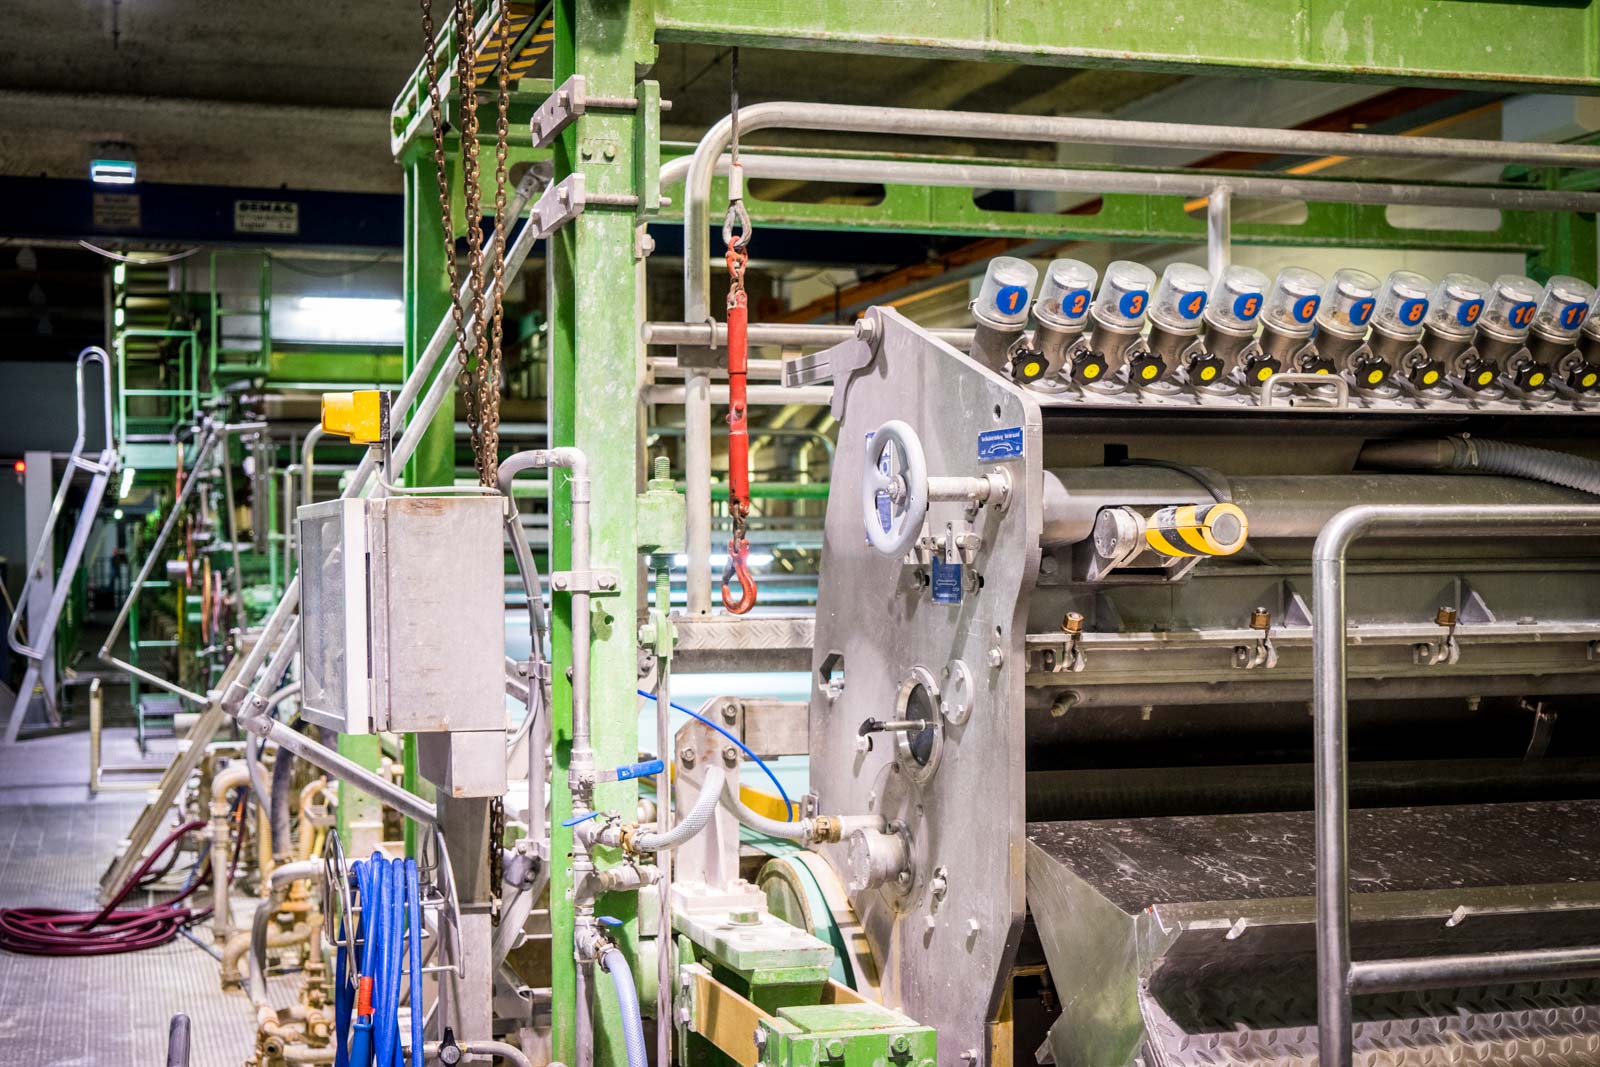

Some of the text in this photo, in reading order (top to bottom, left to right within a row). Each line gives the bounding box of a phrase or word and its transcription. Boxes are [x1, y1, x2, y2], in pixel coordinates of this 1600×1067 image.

[1009, 292, 1018, 309] 1
[1071, 295, 1085, 313] 2
[1129, 296, 1143, 313] 3
[1188, 297, 1202, 313] 4
[1243, 298, 1256, 316] 5
[1302, 301, 1316, 318] 6
[1360, 303, 1372, 320] 7
[1408, 304, 1422, 321] 8
[1466, 304, 1480, 321] 9
[1515, 307, 1535, 323] 10
[1567, 307, 1586, 324] 11
